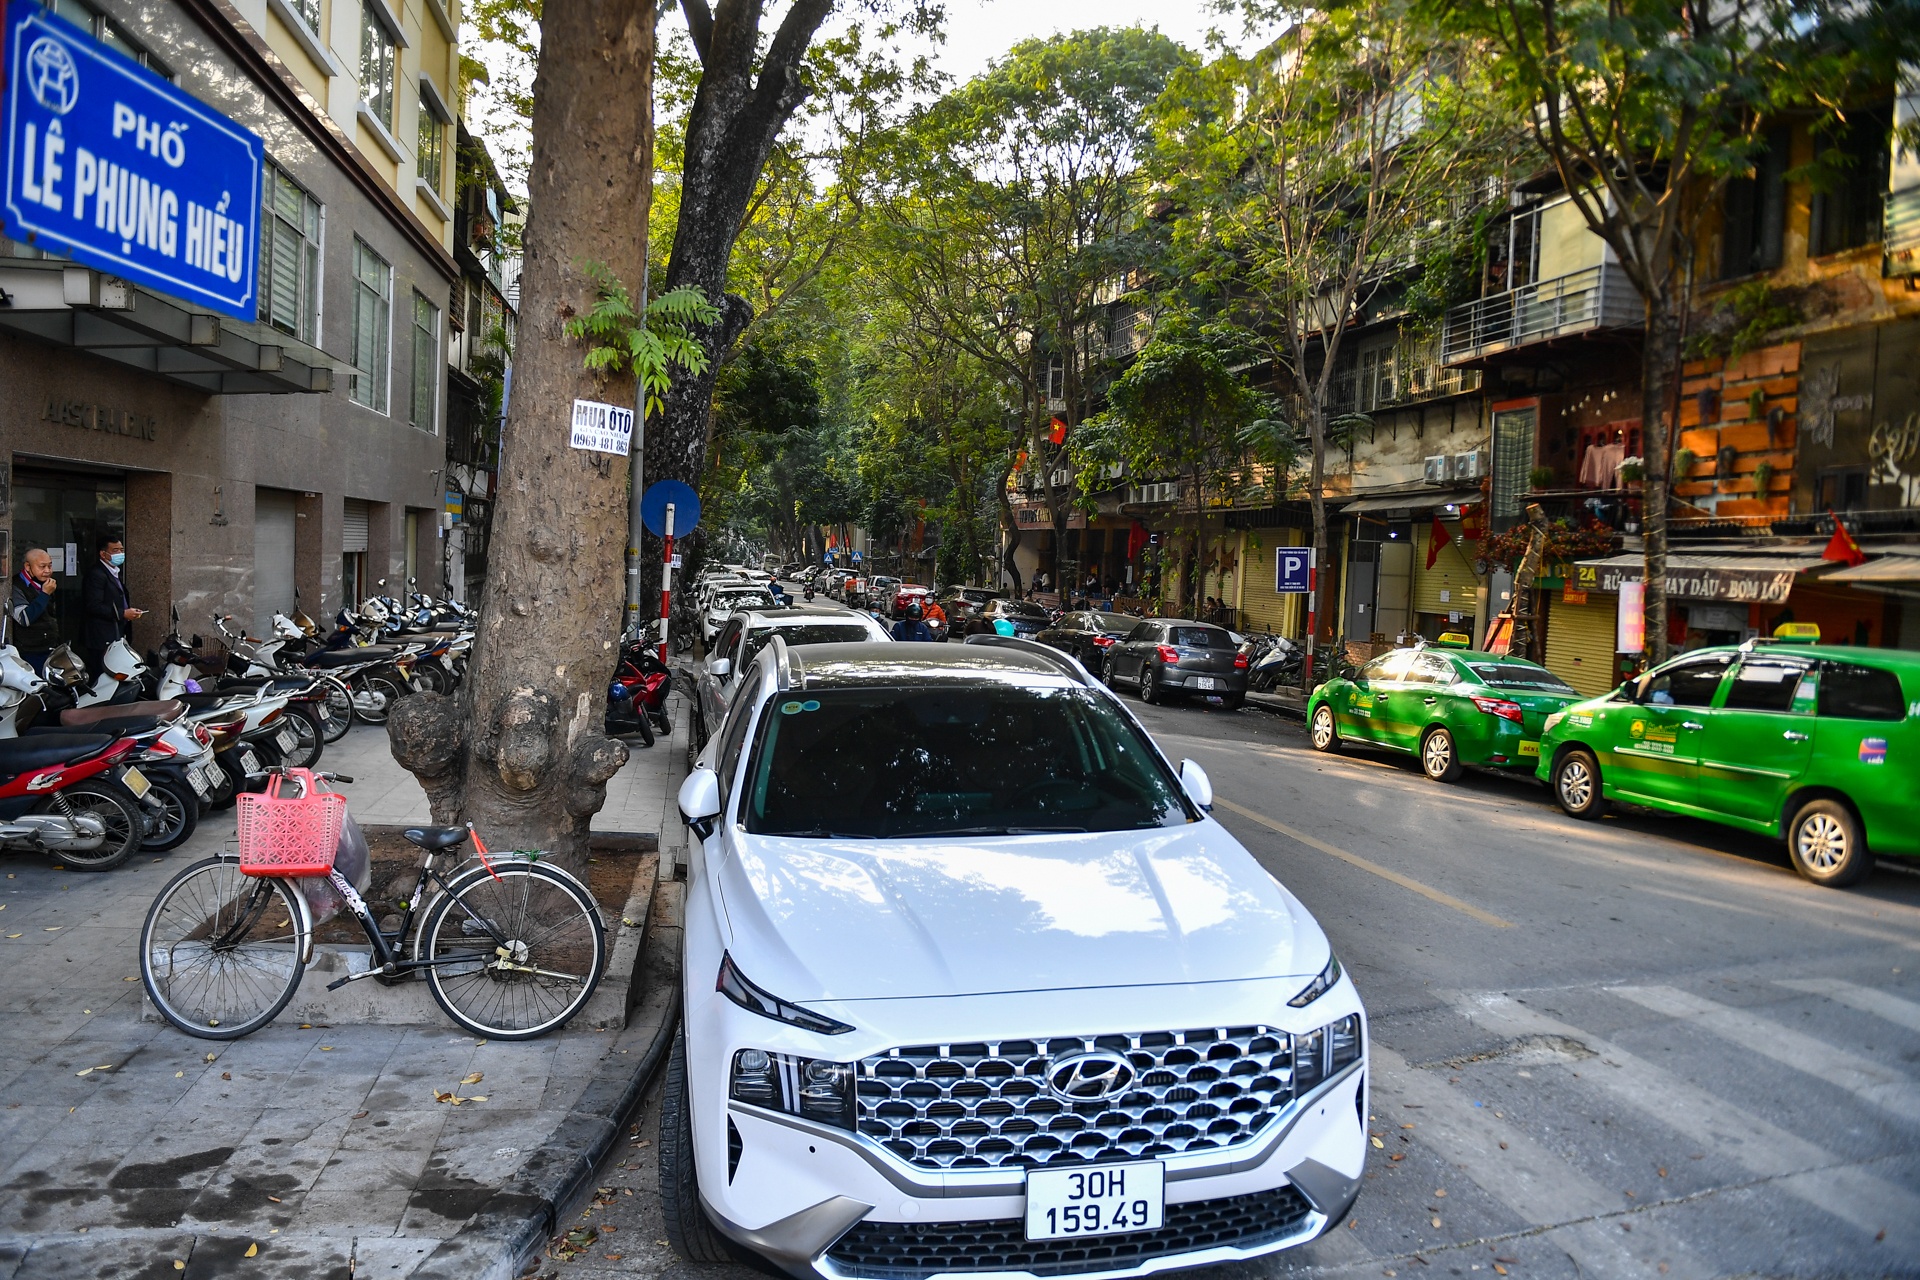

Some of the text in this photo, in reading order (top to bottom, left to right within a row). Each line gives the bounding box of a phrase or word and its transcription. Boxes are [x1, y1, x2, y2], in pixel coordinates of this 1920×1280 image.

[112, 101, 189, 168] PHỐ
[22, 118, 244, 283] LÊ PHỤNG HIỂU
[577, 405, 631, 434] MUA ÔTÔ
[574, 433, 596, 447] 0969
[599, 437, 613, 450] 481
[1284, 556, 1302, 579] P
[1579, 567, 1597, 581] 2A
[1068, 1169, 1125, 1200] 30H
[1047, 1200, 1148, 1234] 159.49
